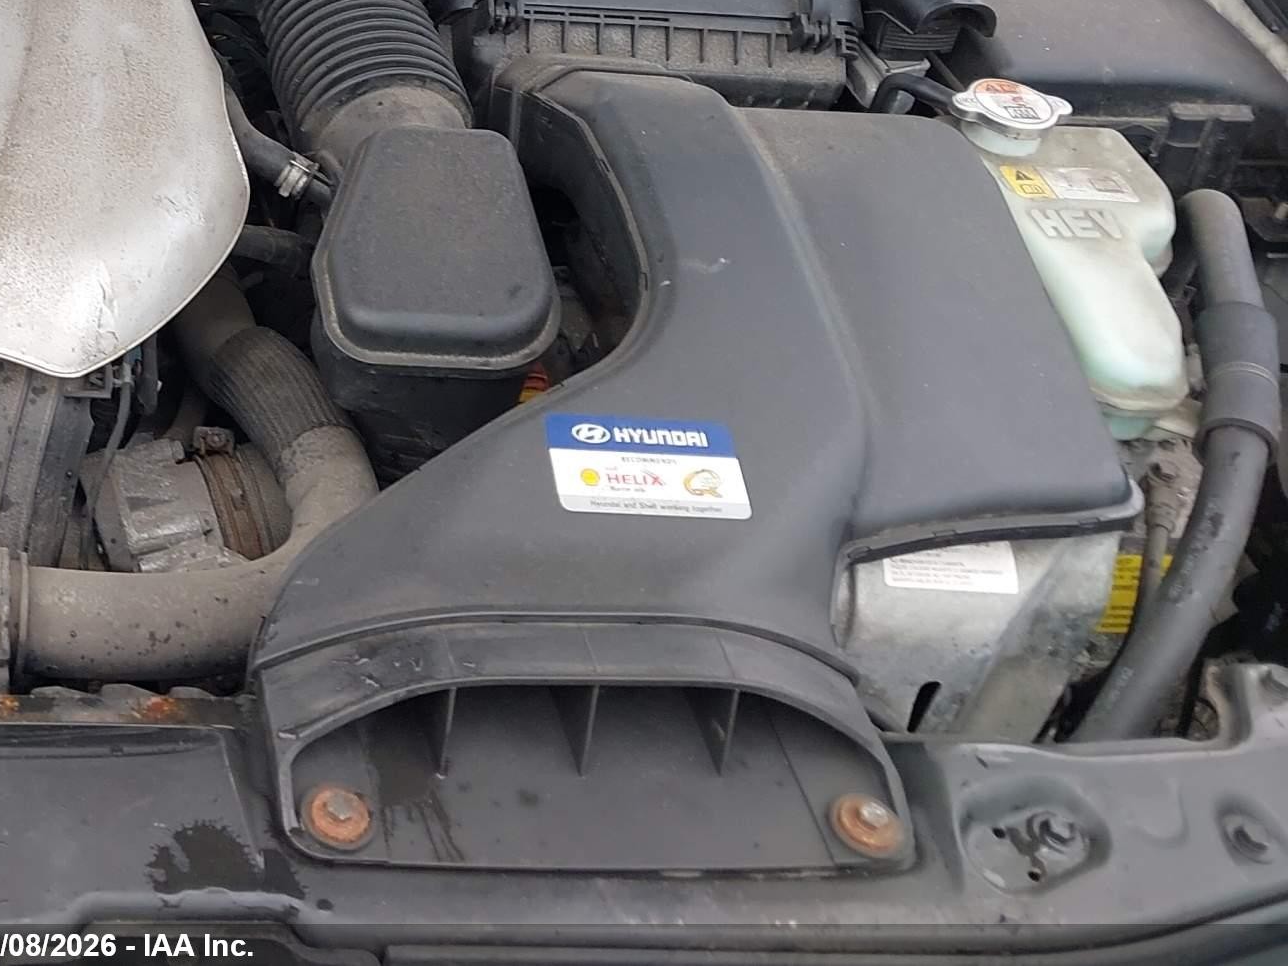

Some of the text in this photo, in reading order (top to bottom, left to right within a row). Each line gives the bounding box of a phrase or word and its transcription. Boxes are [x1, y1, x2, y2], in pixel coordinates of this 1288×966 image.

[1029, 208, 1124, 240] HEV
[613, 426, 709, 448] HYUNDAI
[605, 472, 665, 487] HELIX
